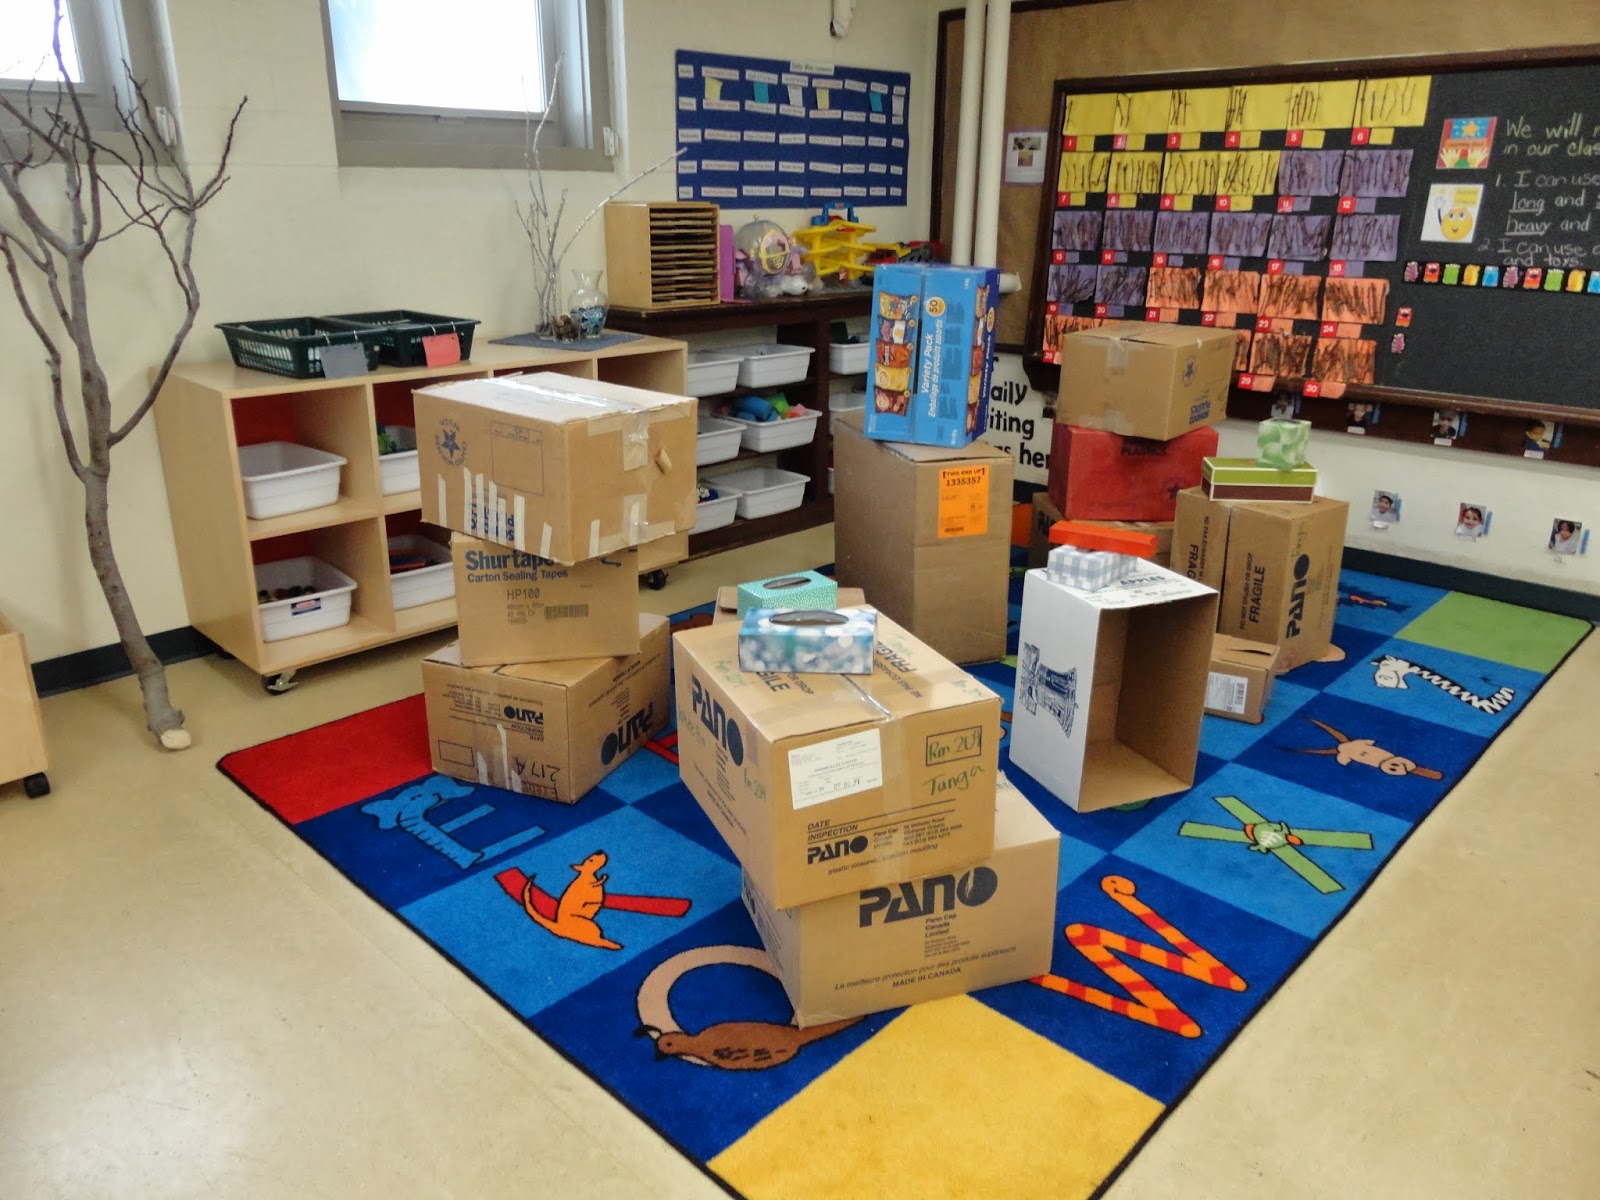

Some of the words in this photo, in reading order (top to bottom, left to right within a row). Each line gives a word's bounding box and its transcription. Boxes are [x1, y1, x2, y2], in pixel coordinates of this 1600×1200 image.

[1506, 115, 1531, 139] We
[1546, 112, 1582, 139] will
[1503, 143, 1518, 155] in
[1526, 142, 1559, 156] our
[1514, 169, 1532, 187] I
[1535, 174, 1567, 187] can
[1510, 190, 1545, 216] long
[1554, 188, 1586, 207] and
[1505, 214, 1552, 235] heavy
[1561, 212, 1592, 232] and
[1503, 252, 1534, 267] and
[1516, 241, 1550, 255] can
[1553, 243, 1586, 257] use
[929, 300, 939, 313] 50
[934, 319, 943, 344] assortis
[924, 333, 934, 357] Pack
[932, 346, 941, 374] produits
[921, 358, 933, 393] Variety
[932, 374, 939, 383] de
[928, 384, 938, 417] Emballage
[990, 381, 1028, 406] aily
[988, 407, 1035, 441] iting
[946, 476, 982, 487] 1335357
[1187, 543, 1199, 579] FRAG
[467, 573, 500, 583] Carton
[503, 571, 537, 581] Sealing
[540, 569, 568, 579] Tapes
[1119, 575, 1166, 587] APPLES
[507, 588, 540, 601] HP100
[1241, 583, 1250, 605] CRUSH
[1248, 566, 1265, 623] FRAGILE
[1286, 554, 1310, 638] PANO
[756, 670, 791, 693] GILE
[503, 705, 544, 725] PANO
[691, 673, 744, 767] PANO
[601, 702, 653, 765] PANO
[928, 740, 951, 762] Rm
[515, 757, 526, 776] A
[531, 763, 561, 782] 217
[921, 765, 984, 796] Tanga
[807, 819, 831, 831] DATE
[807, 824, 858, 841] INSPECTION
[807, 835, 869, 865] PANO
[828, 864, 849, 875] plastic
[859, 866, 998, 928] PANO
[925, 916, 942, 924] Pano
[944, 912, 957, 920] Cap
[925, 921, 950, 931] Canada
[925, 929, 950, 938] Limited
[834, 982, 845, 990] La
[846, 975, 880, 989] meilleure
[881, 967, 918, 982] protection
[919, 964, 935, 974] pour
[937, 960, 950, 969] des
[951, 954, 979, 967] produits
[892, 977, 916, 988] MADE
[927, 967, 962, 980] CANADA
